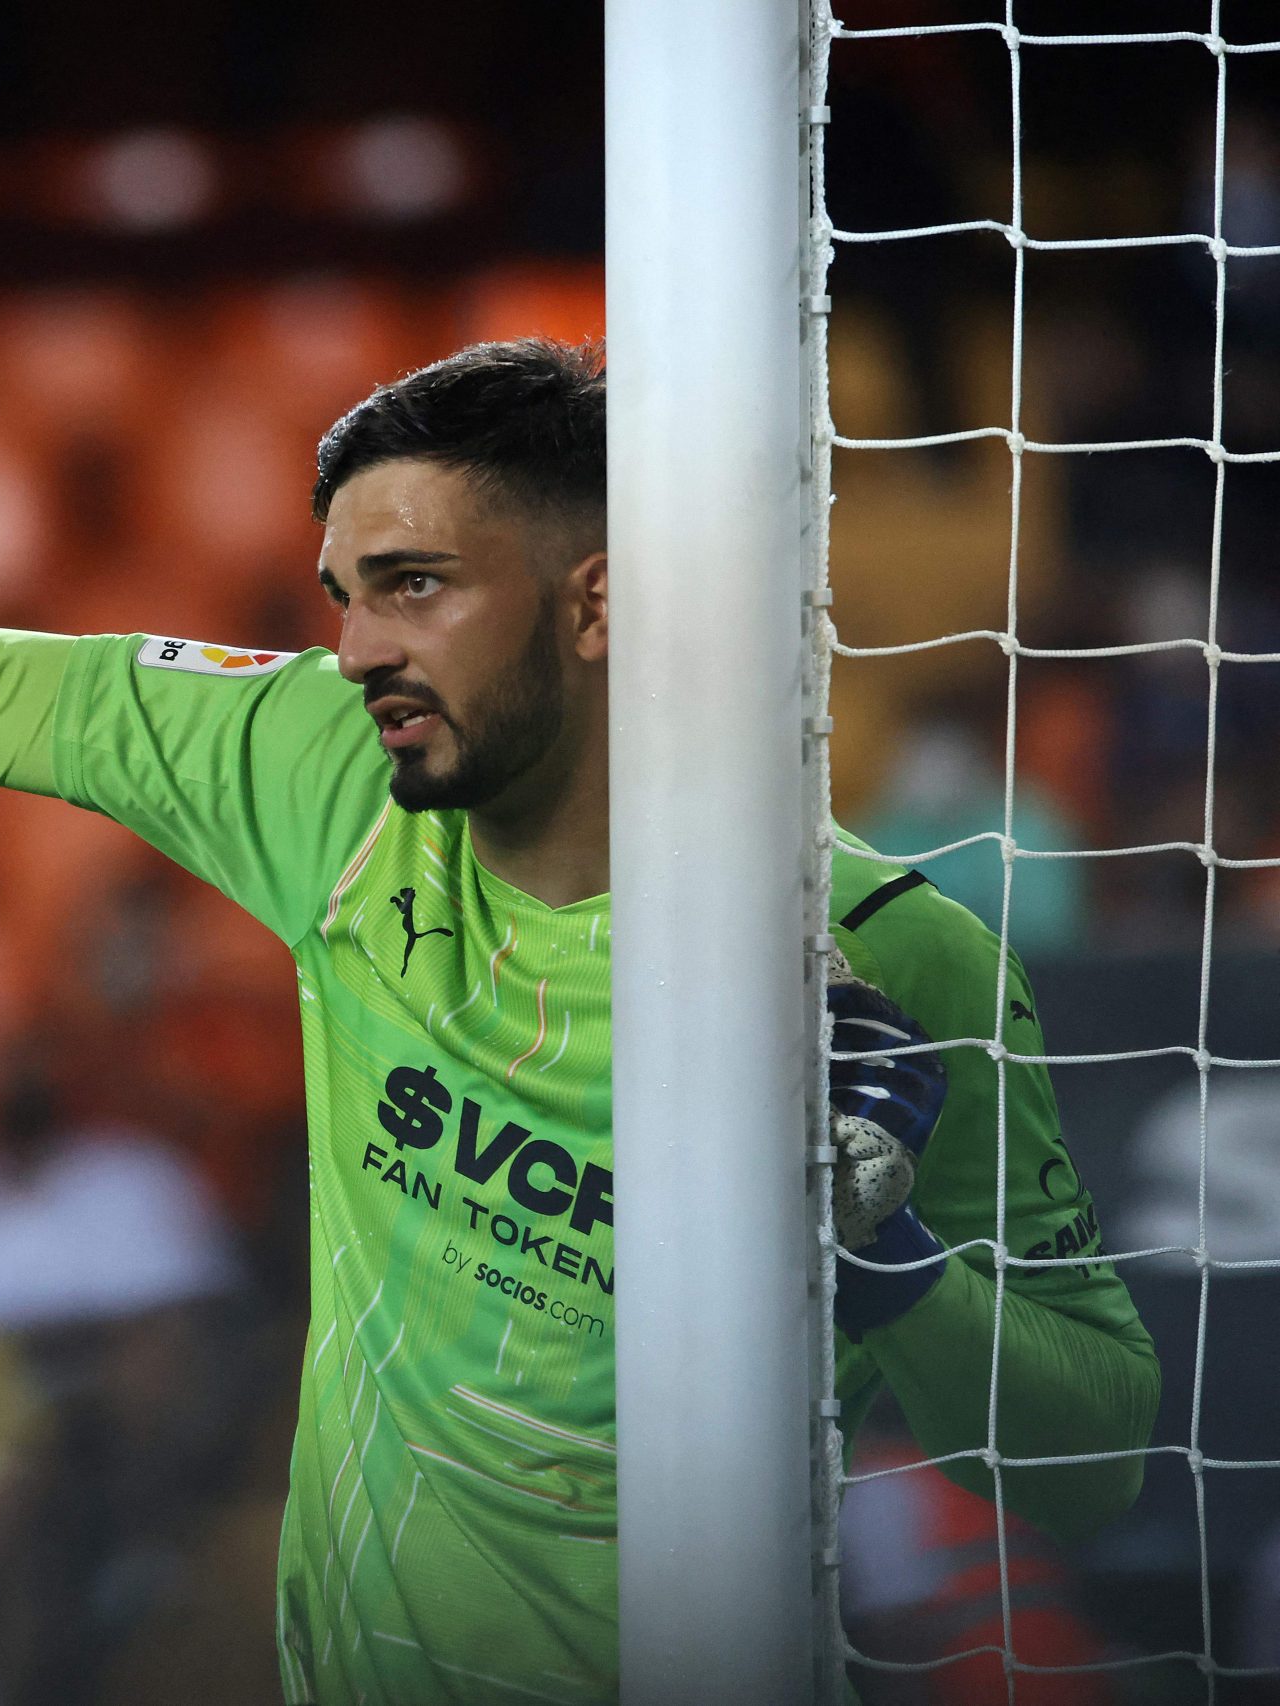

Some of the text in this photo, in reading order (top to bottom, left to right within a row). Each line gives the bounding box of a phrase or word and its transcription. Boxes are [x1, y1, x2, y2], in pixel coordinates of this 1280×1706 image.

[362, 1142, 615, 1296] FAN TOKEN
[442, 1240, 604, 1337] by socios.com
